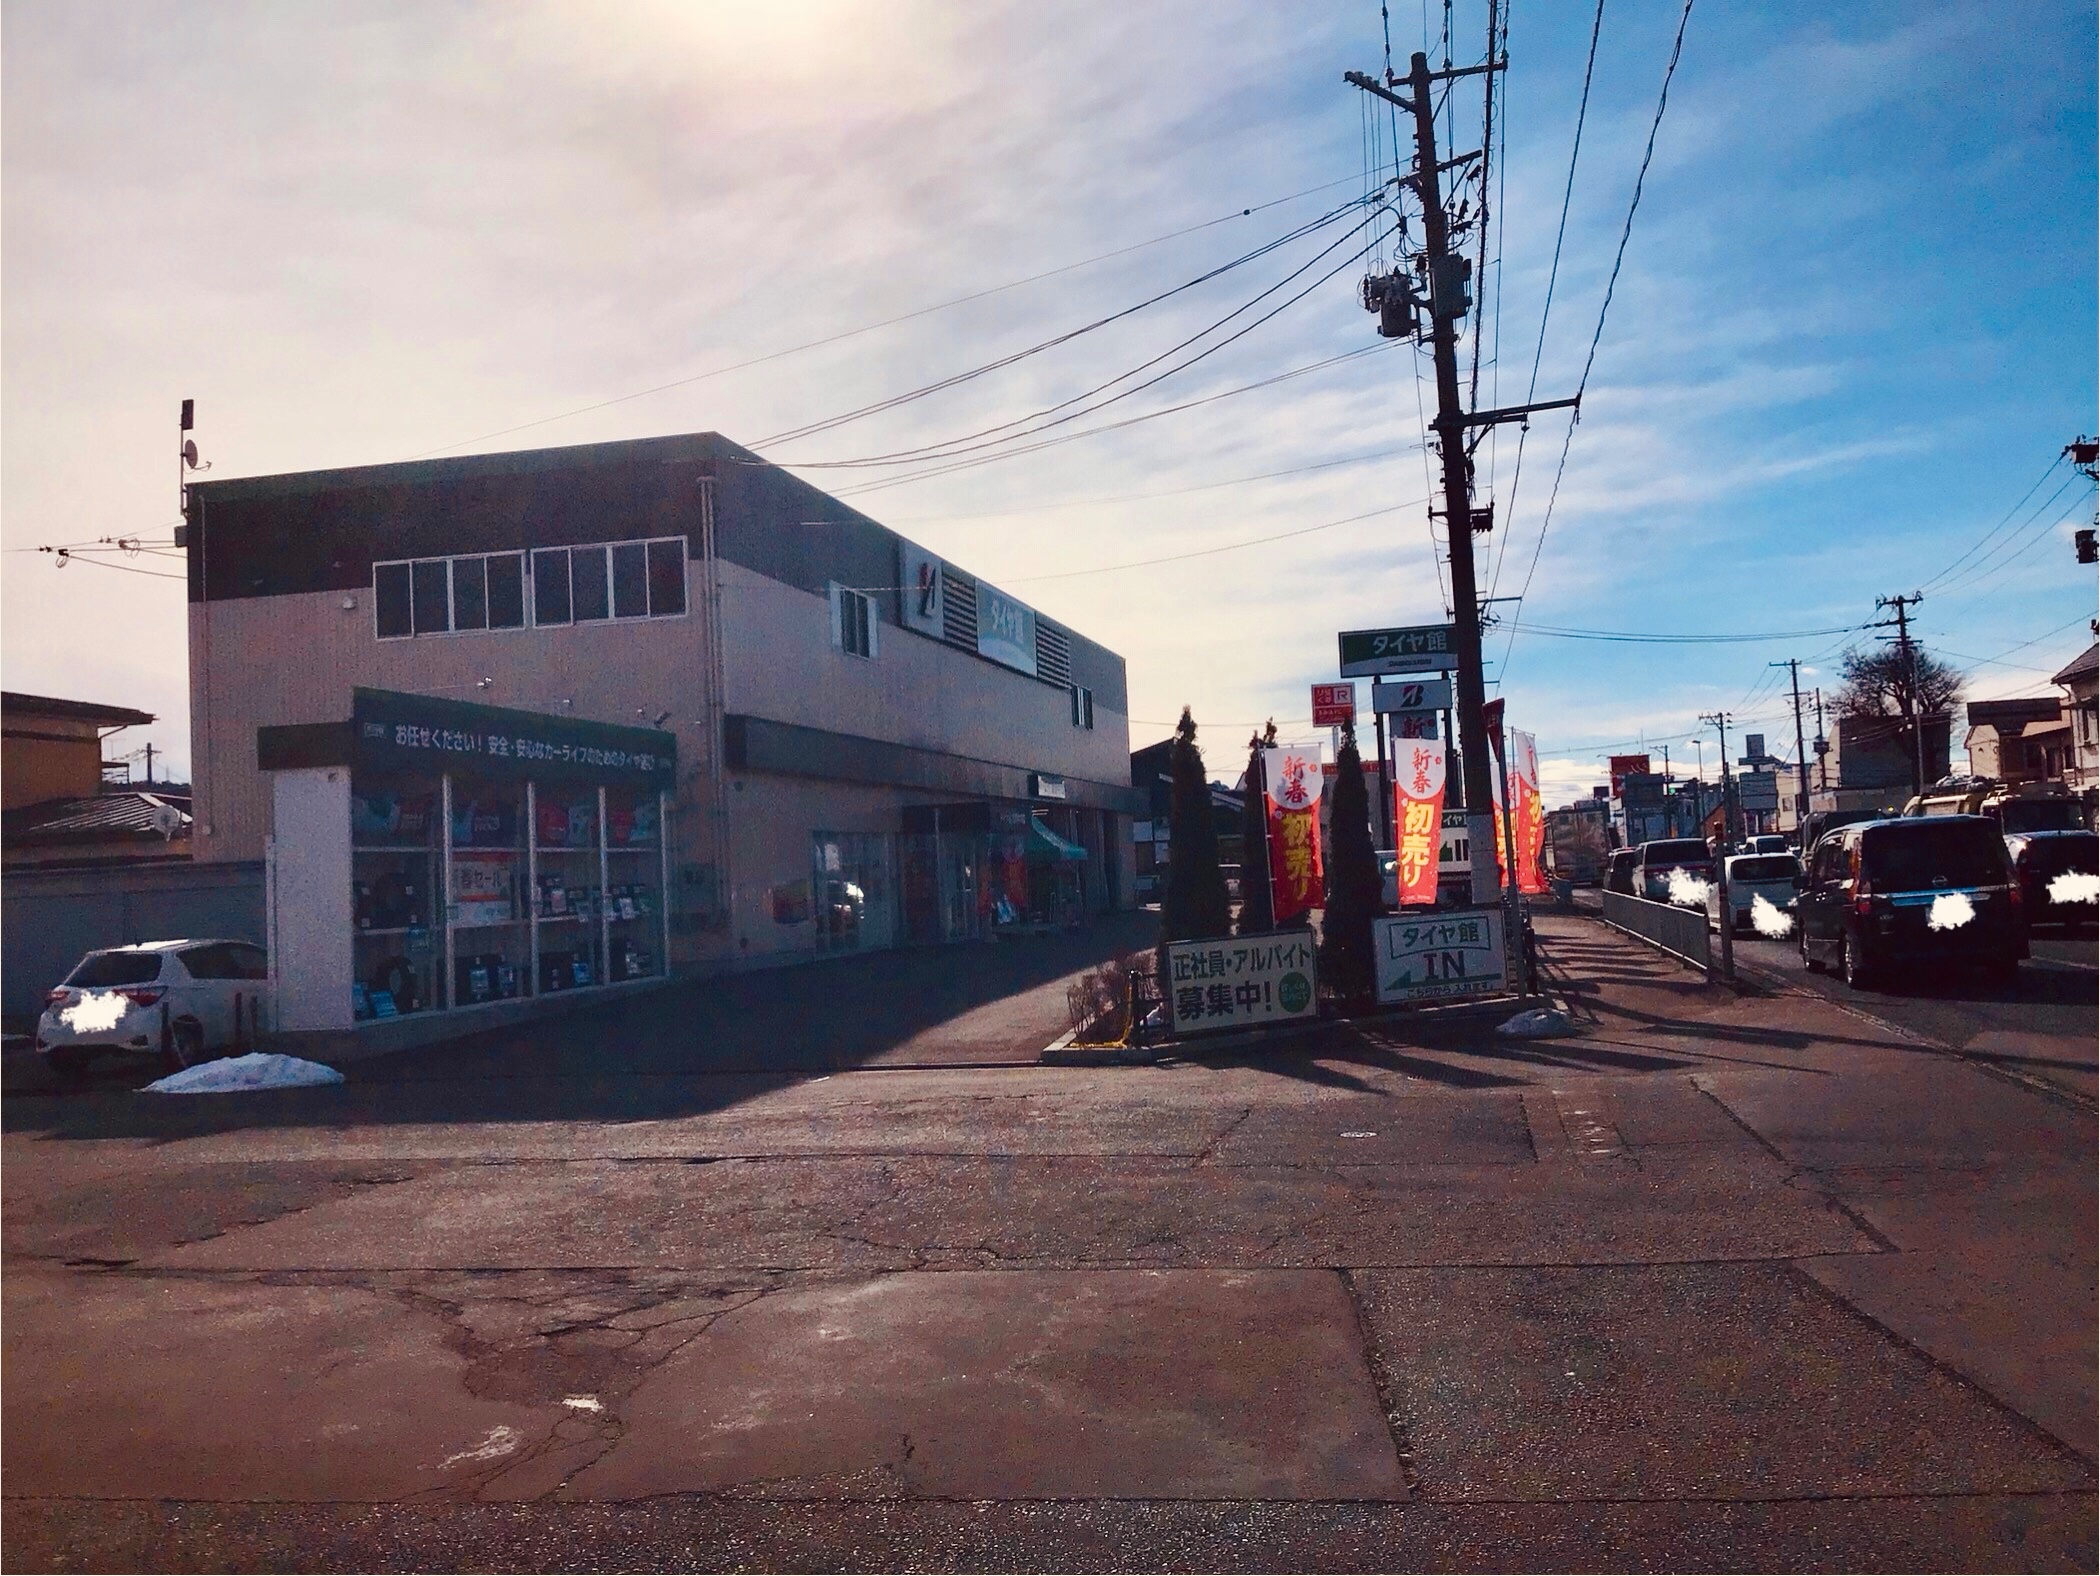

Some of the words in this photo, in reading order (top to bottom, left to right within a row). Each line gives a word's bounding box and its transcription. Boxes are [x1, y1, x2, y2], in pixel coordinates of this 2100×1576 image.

[1372, 631, 1447, 655] タイヤ館
[1282, 755, 1309, 804] 新春
[1411, 747, 1432, 794] 新春
[1281, 811, 1313, 902] 初売り
[1401, 799, 1435, 888] 初売り
[1401, 921, 1479, 947] タイヤ館
[1173, 942, 1311, 982] 正社員・アルバイト
[1423, 949, 1466, 979] IN
